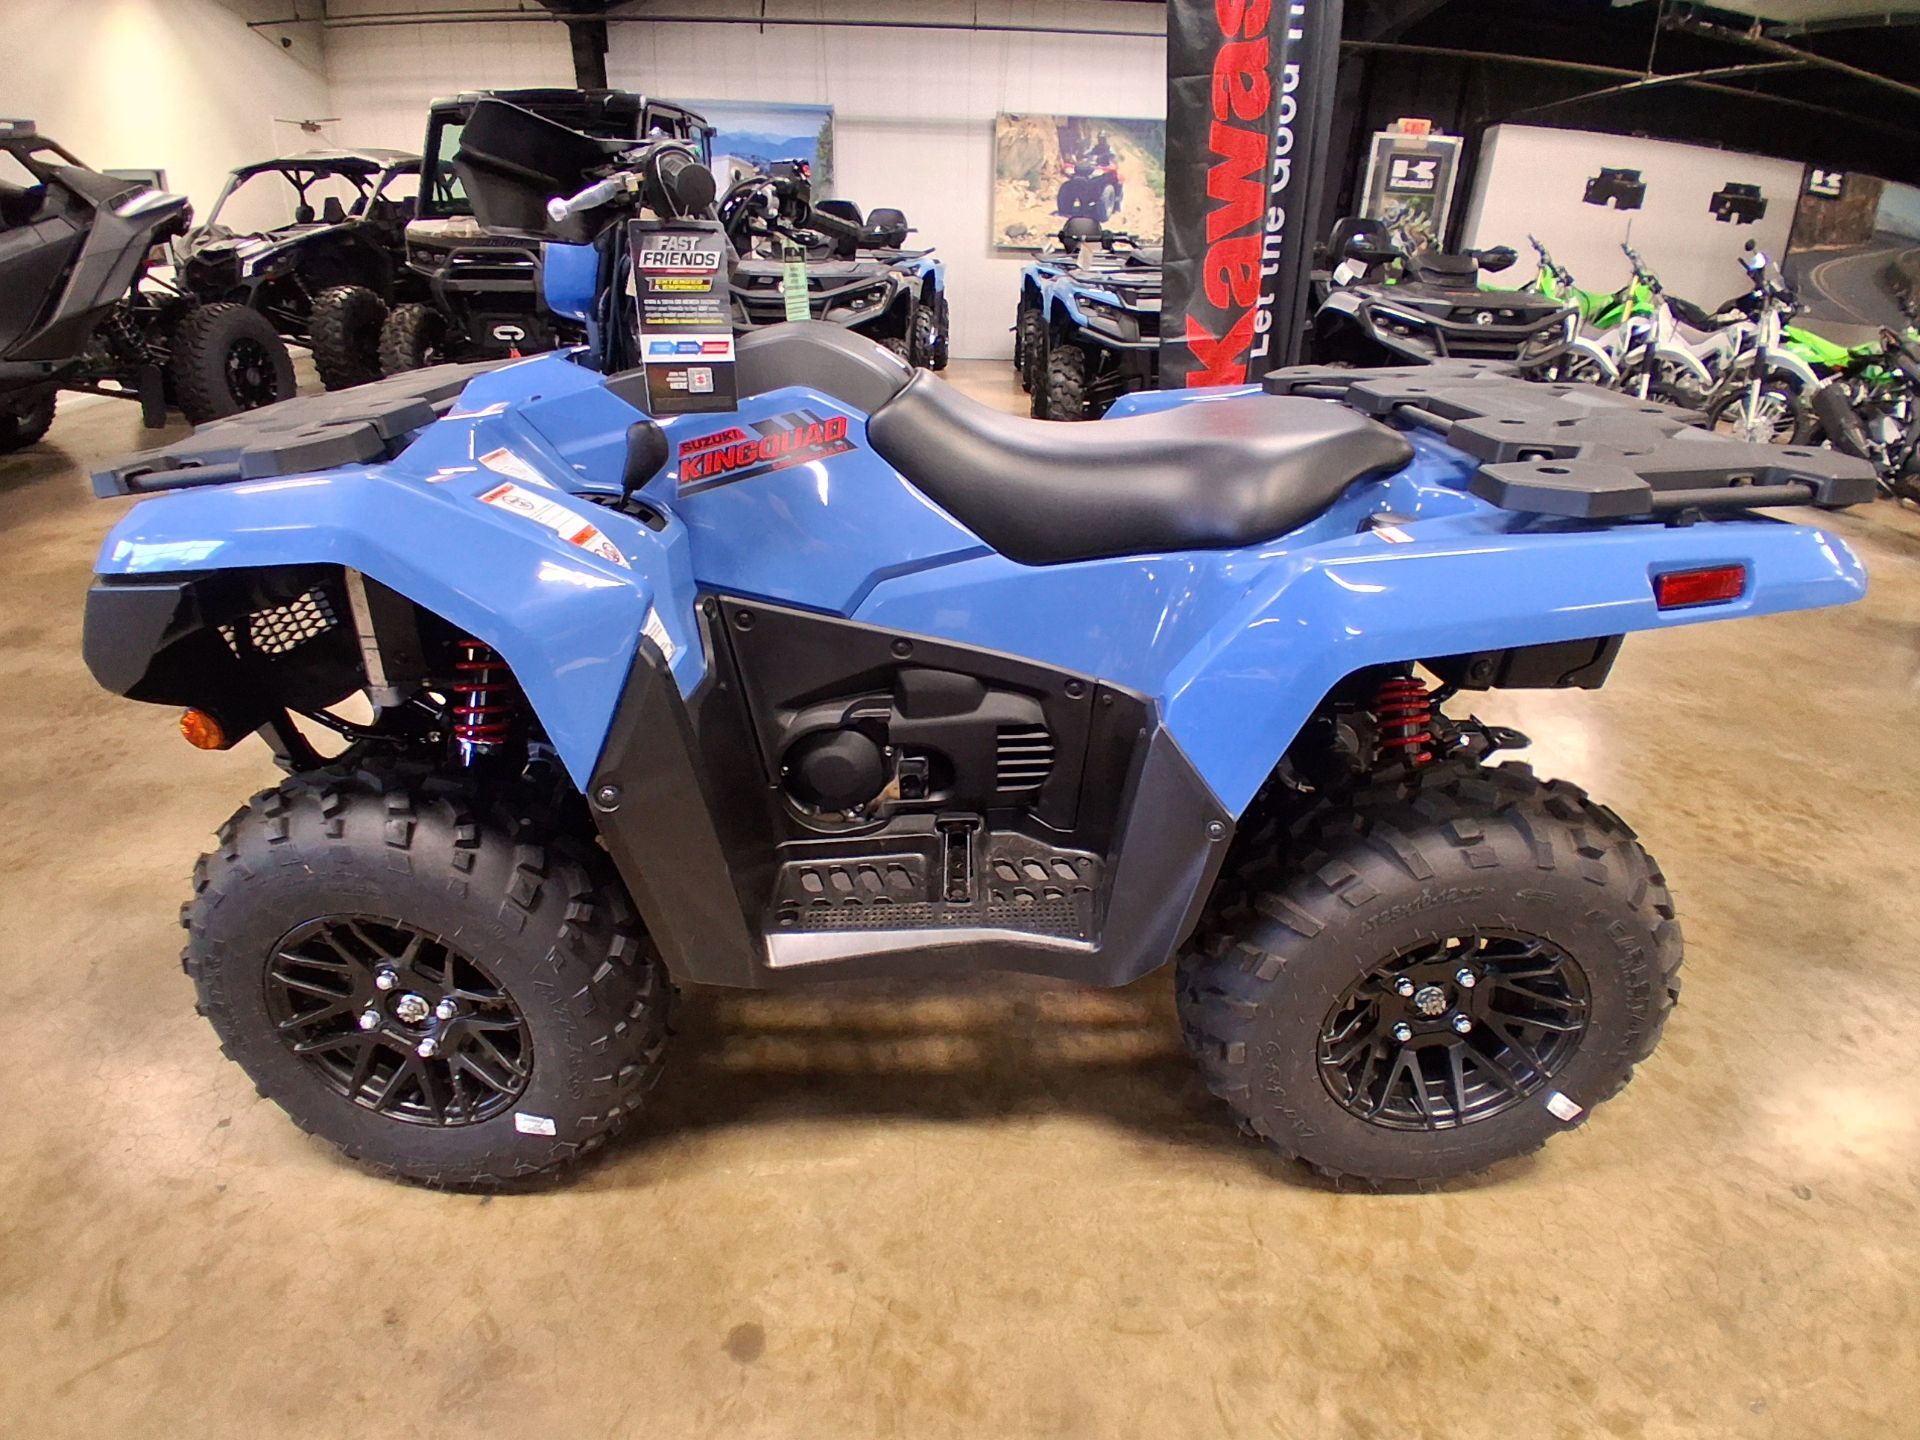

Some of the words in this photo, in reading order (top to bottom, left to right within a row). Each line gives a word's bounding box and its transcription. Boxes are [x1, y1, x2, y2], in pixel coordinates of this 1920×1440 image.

[658, 235, 700, 251] FAST
[643, 251, 716, 267] FRIENDS
[1250, 293, 1275, 358] Let
[679, 416, 848, 484] KINGQUAD
[680, 428, 741, 453] SUZUKI
